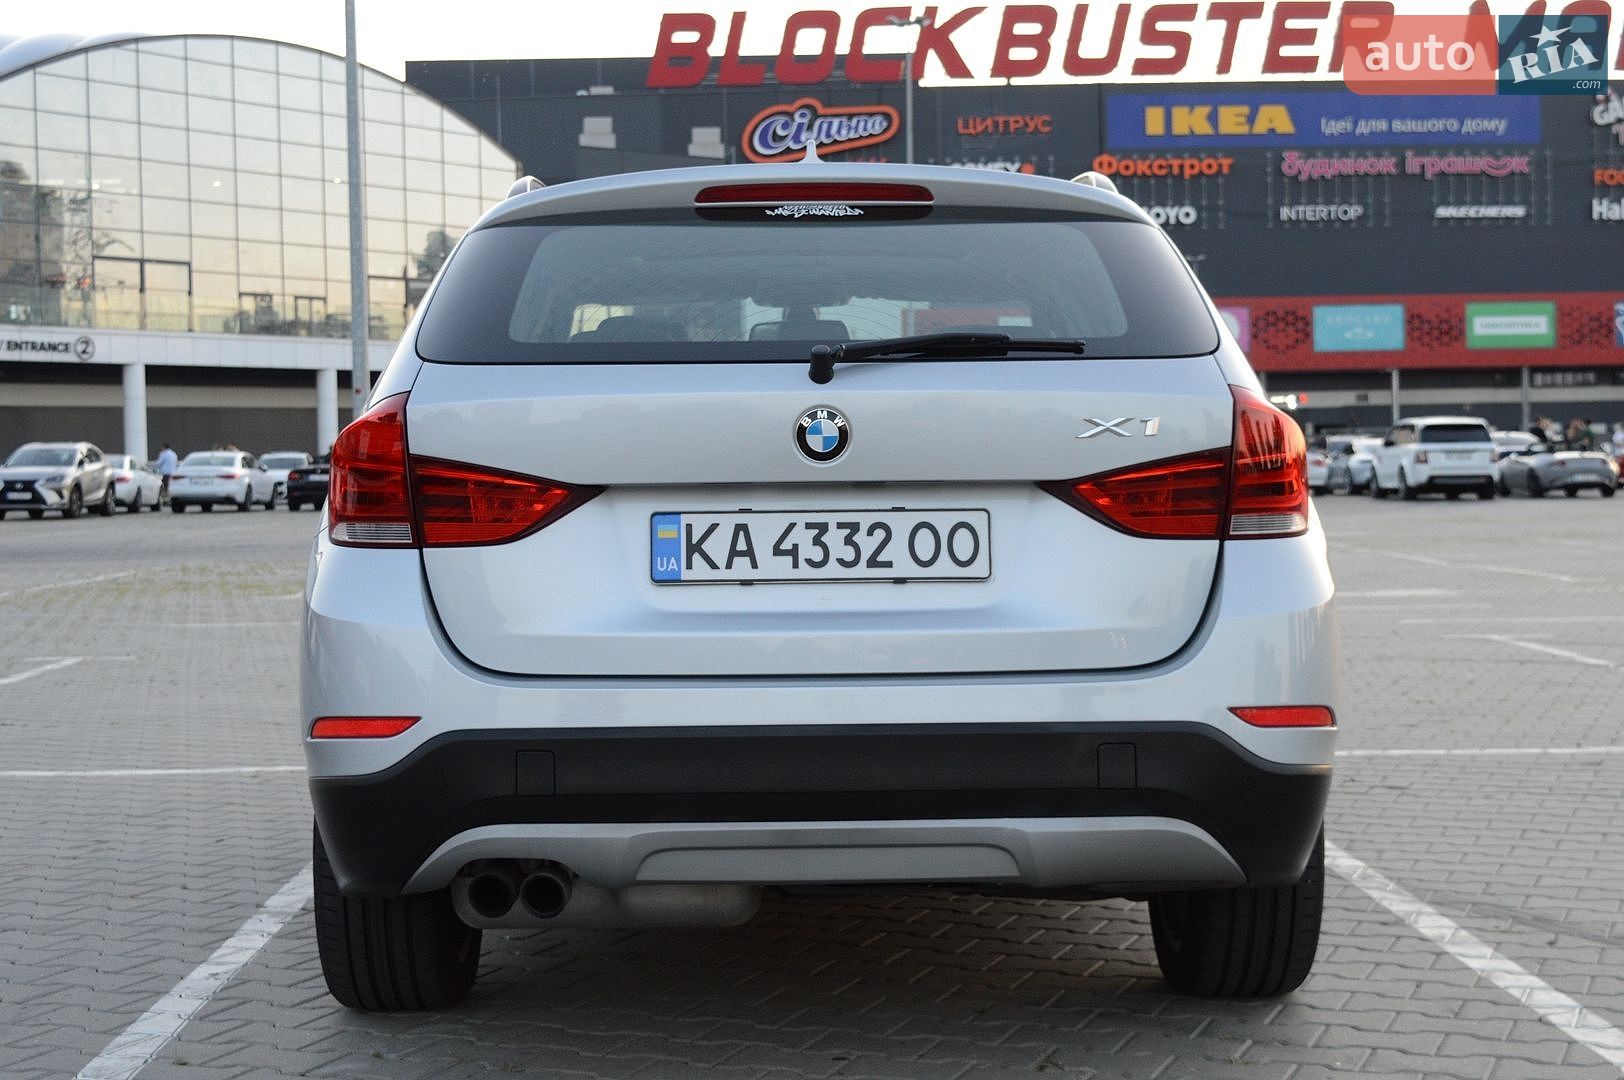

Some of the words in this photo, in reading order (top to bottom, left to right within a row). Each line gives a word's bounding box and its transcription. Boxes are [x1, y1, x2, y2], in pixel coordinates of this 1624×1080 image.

[645, 0, 1396, 88] BLOCKBUSTER
[956, 114, 1054, 135] ЦИТРУС
[1144, 104, 1296, 136] IKEA
[1355, 117, 1389, 136] для
[1391, 117, 1459, 134] вашого
[1461, 117, 1508, 136] дому
[1092, 153, 1234, 178] Фокстрот
[1143, 205, 1198, 225] OYO
[1279, 204, 1364, 222] INTERTOP
[1434, 204, 1528, 219] SKECHERS
[6, 340, 72, 354] ENTRANCE
[801, 410, 846, 428] BMW
[1075, 416, 1161, 438] X1
[685, 522, 760, 571] KA
[771, 521, 894, 570] 4332
[656, 556, 679, 573] UA
